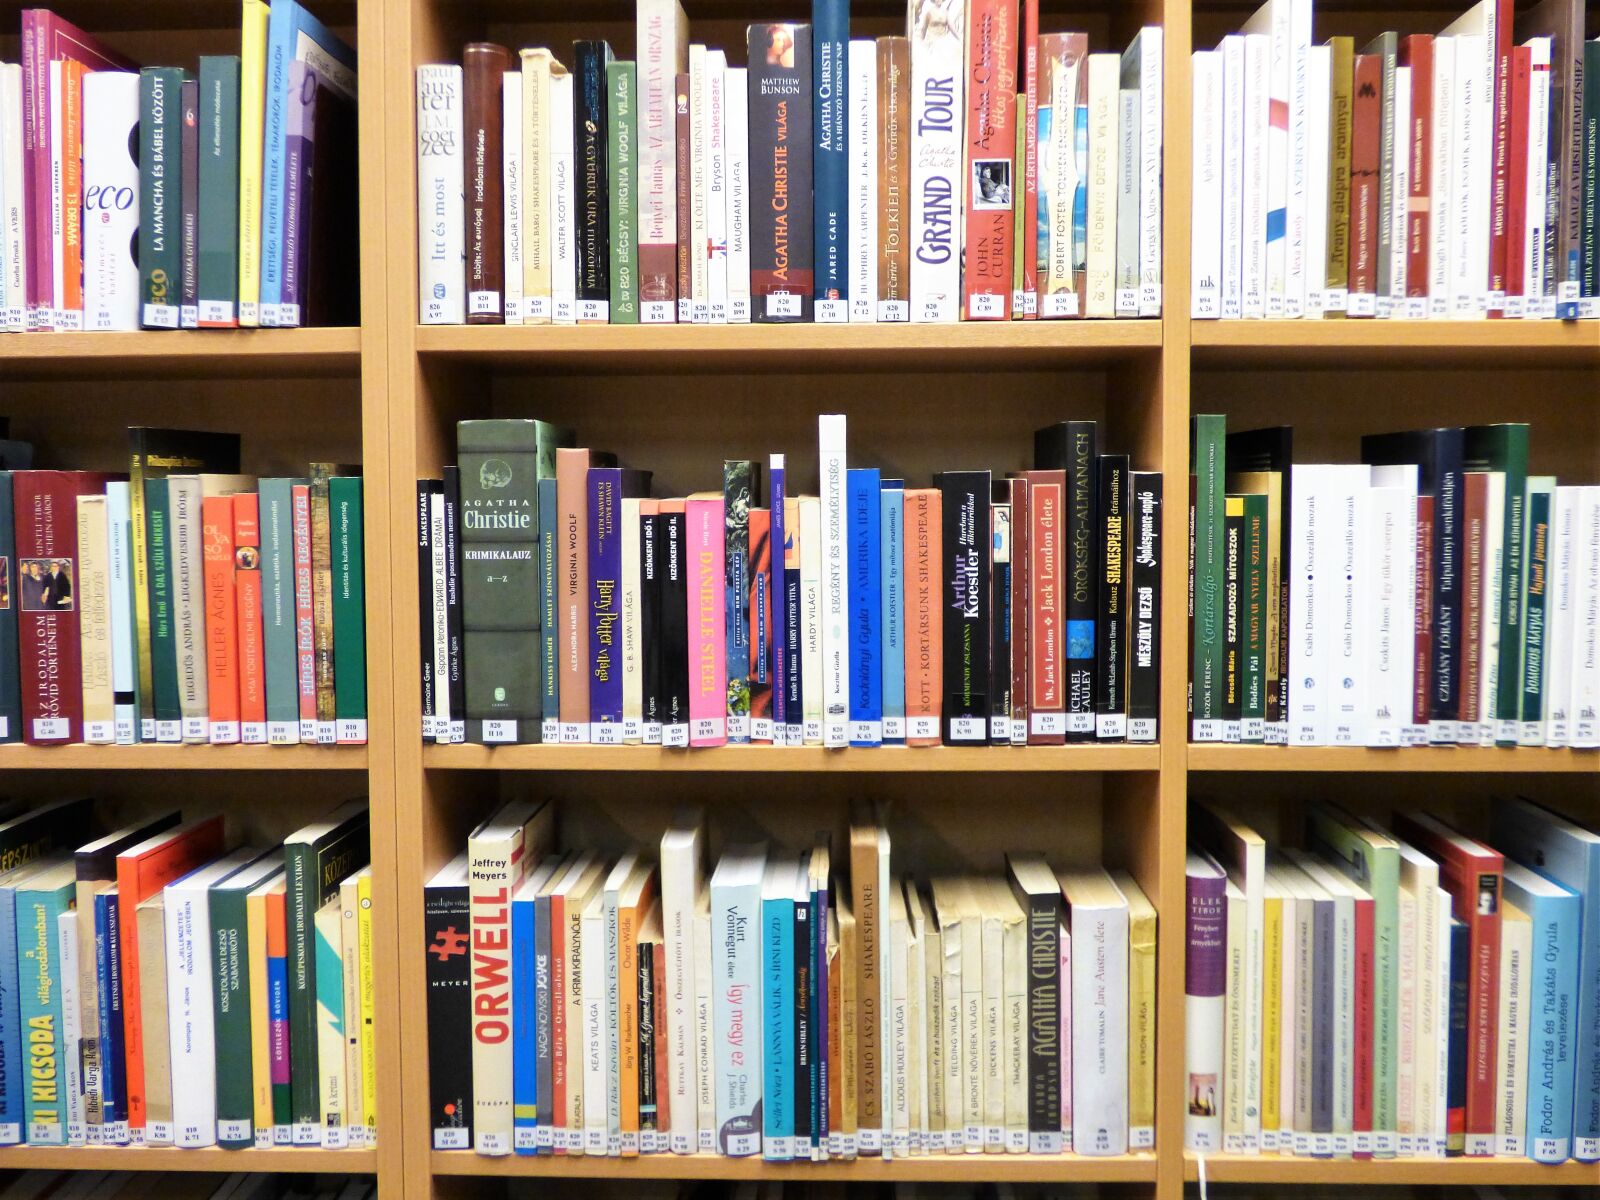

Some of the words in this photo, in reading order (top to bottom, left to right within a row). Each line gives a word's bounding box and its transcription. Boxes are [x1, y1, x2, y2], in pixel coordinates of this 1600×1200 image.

[820, 42, 831, 98] CHRISTIE
[149, 76, 162, 124] KÖZÖTT
[761, 87, 800, 95] BUNSON
[919, 77, 953, 137] TOUR
[710, 77, 721, 148] Shakespeare
[777, 101, 787, 140] VILÁGA
[821, 101, 831, 150] AGATHA
[149, 128, 162, 161] BÁBEL
[151, 164, 163, 177] ÉS
[556, 161, 565, 191] VILÁGA
[712, 155, 722, 192] Bryson
[732, 162, 741, 196] VILÁGA
[772, 146, 788, 210] CHRISTIE
[85, 185, 134, 211] eco
[152, 180, 163, 235] MANCHA
[433, 177, 445, 216] most
[557, 195, 565, 222] SCOTT
[431, 222, 445, 236] és
[734, 200, 742, 252] MAUGHAM
[916, 176, 952, 264] GRAND
[153, 237, 163, 251] LA
[432, 243, 446, 260] Itt
[773, 214, 788, 281] AGATHA
[977, 237, 989, 278] JOHN
[992, 214, 1005, 278] CURRAN
[34, 494, 42, 520] TIBOR
[43, 494, 53, 521] GÁBOR
[827, 458, 840, 540] SZEMÉLYISÉG
[1109, 470, 1119, 514] drámáihoz
[340, 502, 349, 532] idegenség
[419, 493, 428, 546] SHAKESPEARE
[446, 502, 454, 531] nemzetei
[465, 510, 530, 528] Christie
[568, 514, 577, 549] WOOLF
[644, 525, 653, 538] IDŐ
[959, 515, 967, 544] Harcban
[967, 493, 975, 545] diktatúrákkal
[1040, 498, 1052, 528] élete
[1075, 433, 1089, 601] ÖRÖKSÉG-ALMANACH
[1136, 492, 1158, 567] Shakespeare-napló
[35, 524, 43, 555] GINTLI
[46, 524, 54, 555] SCHEIN
[341, 534, 349, 562] kulturális
[447, 533, 456, 576] posztmodern
[465, 550, 531, 559] KRIMIKALAUZ
[828, 545, 840, 558] ÉS
[918, 495, 928, 582] SHAKESPEARE
[1041, 532, 1053, 580] London
[1107, 516, 1121, 584] SHAKESPEARE
[569, 552, 577, 595] VIRGINIA
[644, 540, 653, 579] KIZÖKKENT
[211, 572, 226, 619] ÁGNES
[342, 573, 350, 599] Identitás
[448, 578, 456, 605] Rushdie
[596, 580, 615, 611] Harry
[702, 552, 714, 638] DANIELLE
[828, 564, 841, 614] REGÉNY
[951, 555, 965, 611] Arthur
[963, 549, 979, 618] Koestler
[1041, 584, 1054, 612] Jack
[1110, 586, 1118, 613] Kalauz
[806, 587, 816, 619] VILÁGA
[1138, 587, 1152, 618] DEZSŐ
[1305, 583, 1314, 630] Domonkos
[45, 614, 59, 679] TÖRTÉNETE
[449, 636, 458, 656] Ágnes
[598, 613, 618, 645] Potter
[809, 623, 817, 653] HARDY
[918, 587, 929, 670] KORTÁRSUNK
[1044, 629, 1054, 662] London
[1138, 621, 1152, 666] MÉSZÖLY
[1305, 633, 1313, 657] Csábi
[36, 615, 48, 696] IRODALOM
[214, 624, 228, 678] HELLER
[595, 648, 612, 681] világa
[702, 645, 715, 696] STEEL
[1045, 664, 1054, 684] Jack
[922, 681, 930, 712] KOTT
[1046, 687, 1054, 701] Ms.
[472, 859, 507, 867] Jeffrey
[472, 872, 507, 880] Meyers
[727, 906, 738, 958] Vonnegut
[736, 917, 747, 941] Kurt
[862, 883, 873, 979] SHAKESPEARE
[1032, 907, 1056, 978] CHRISTIE
[1544, 922, 1558, 963] Gyula
[35, 904, 52, 1005] világirodalomban?
[473, 887, 509, 1044] ORWELL
[1543, 968, 1556, 1014] Takáts
[590, 1003, 599, 1037] VILÁGA
[728, 1010, 743, 1045] megy
[862, 998, 873, 1048] LÁSZLÓ
[895, 1005, 904, 1038] VILÁGA
[1033, 985, 1056, 1056] AGATHA
[1543, 1020, 1555, 1034] és
[1557, 994, 1569, 1062] levelezése
[29, 1015, 57, 1101] KICSODA
[591, 1040, 599, 1071] KEATS
[730, 1052, 742, 1066] ez
[862, 1052, 873, 1094] SZABÓ
[897, 1041, 905, 1074] HUXLEY
[1541, 1039, 1555, 1089] András
[897, 1077, 905, 1111] ALDOUS
[1540, 1095, 1553, 1134] Fodor
